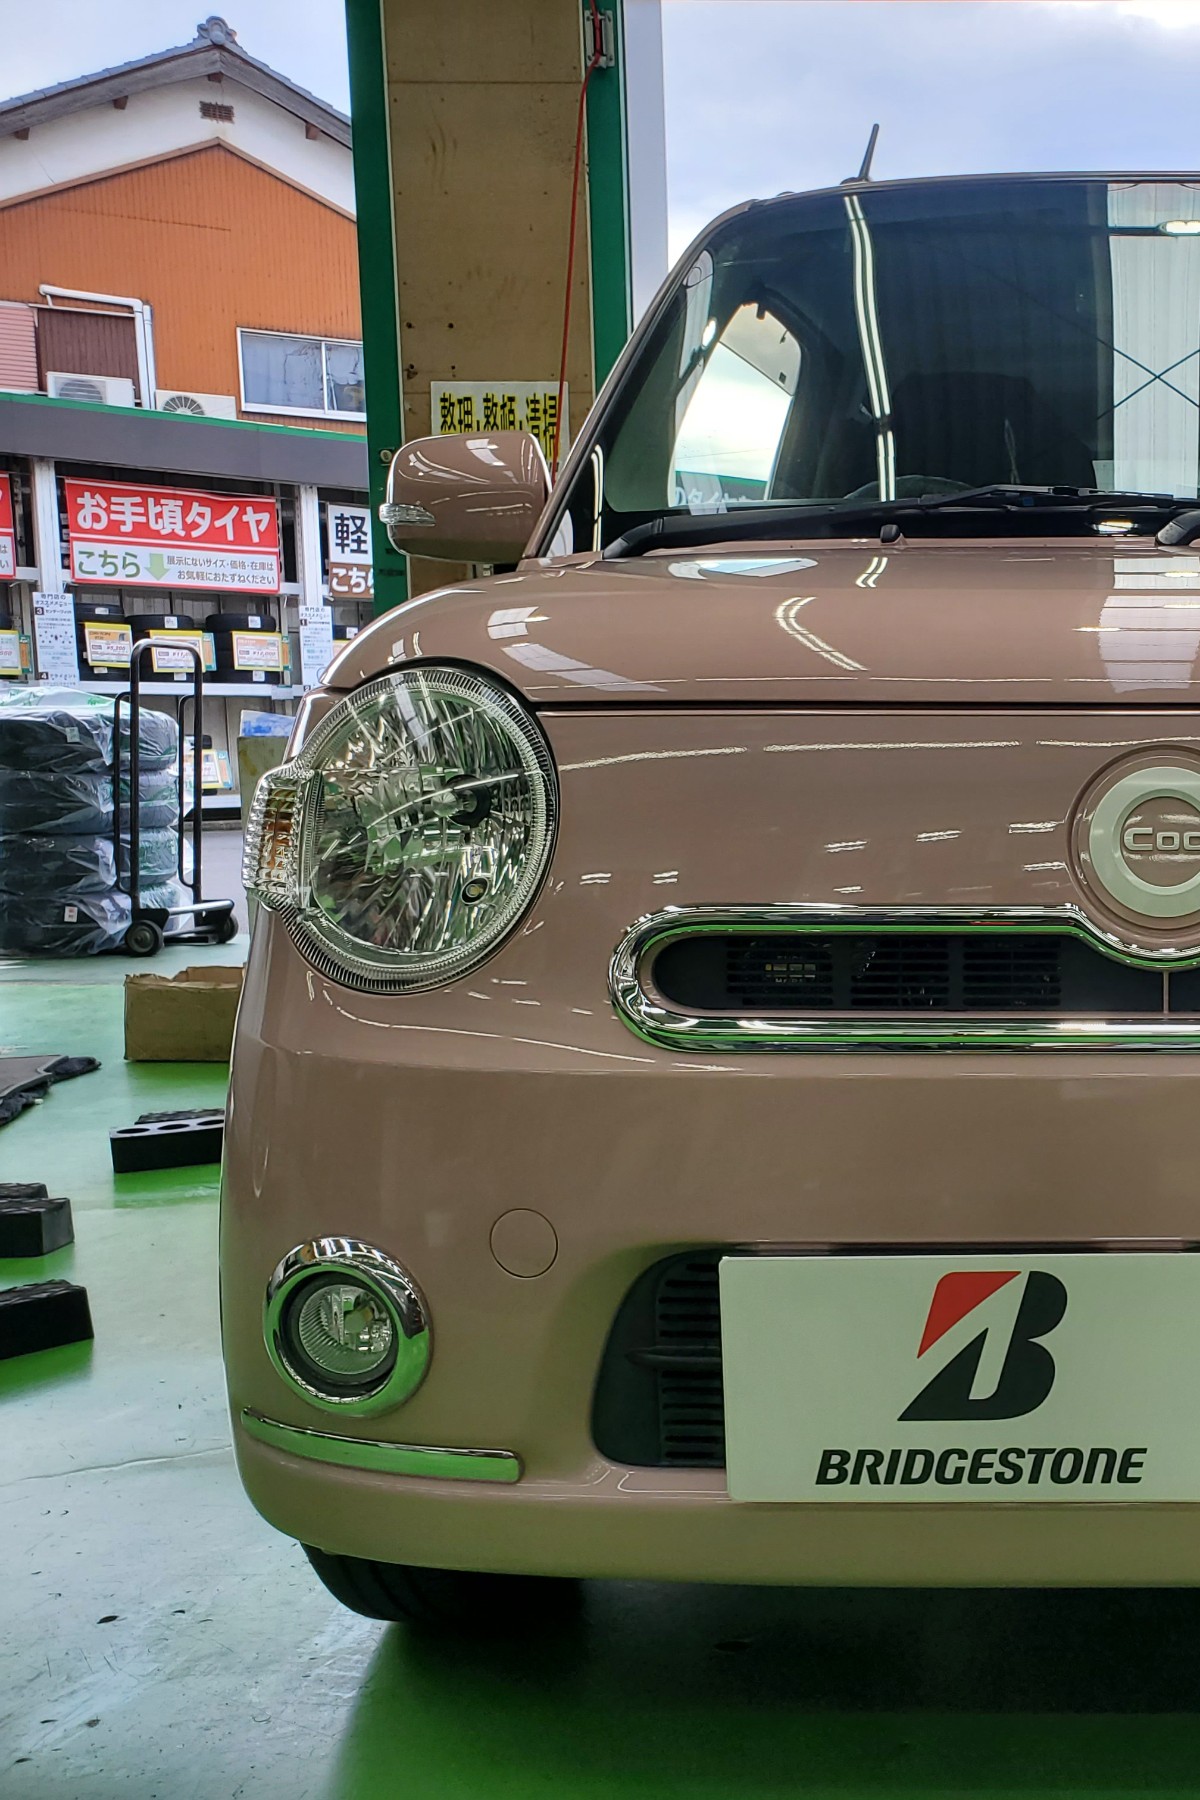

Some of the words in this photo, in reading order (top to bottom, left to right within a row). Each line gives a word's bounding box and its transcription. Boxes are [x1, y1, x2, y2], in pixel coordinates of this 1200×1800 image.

[76, 491, 270, 543] お手頃タイヤ
[334, 513, 368, 554] 軽
[78, 550, 140, 579] こちら
[177, 570, 275, 585] お気軽におたずねください
[815, 1447, 1148, 1486] BRIDGESTONE
